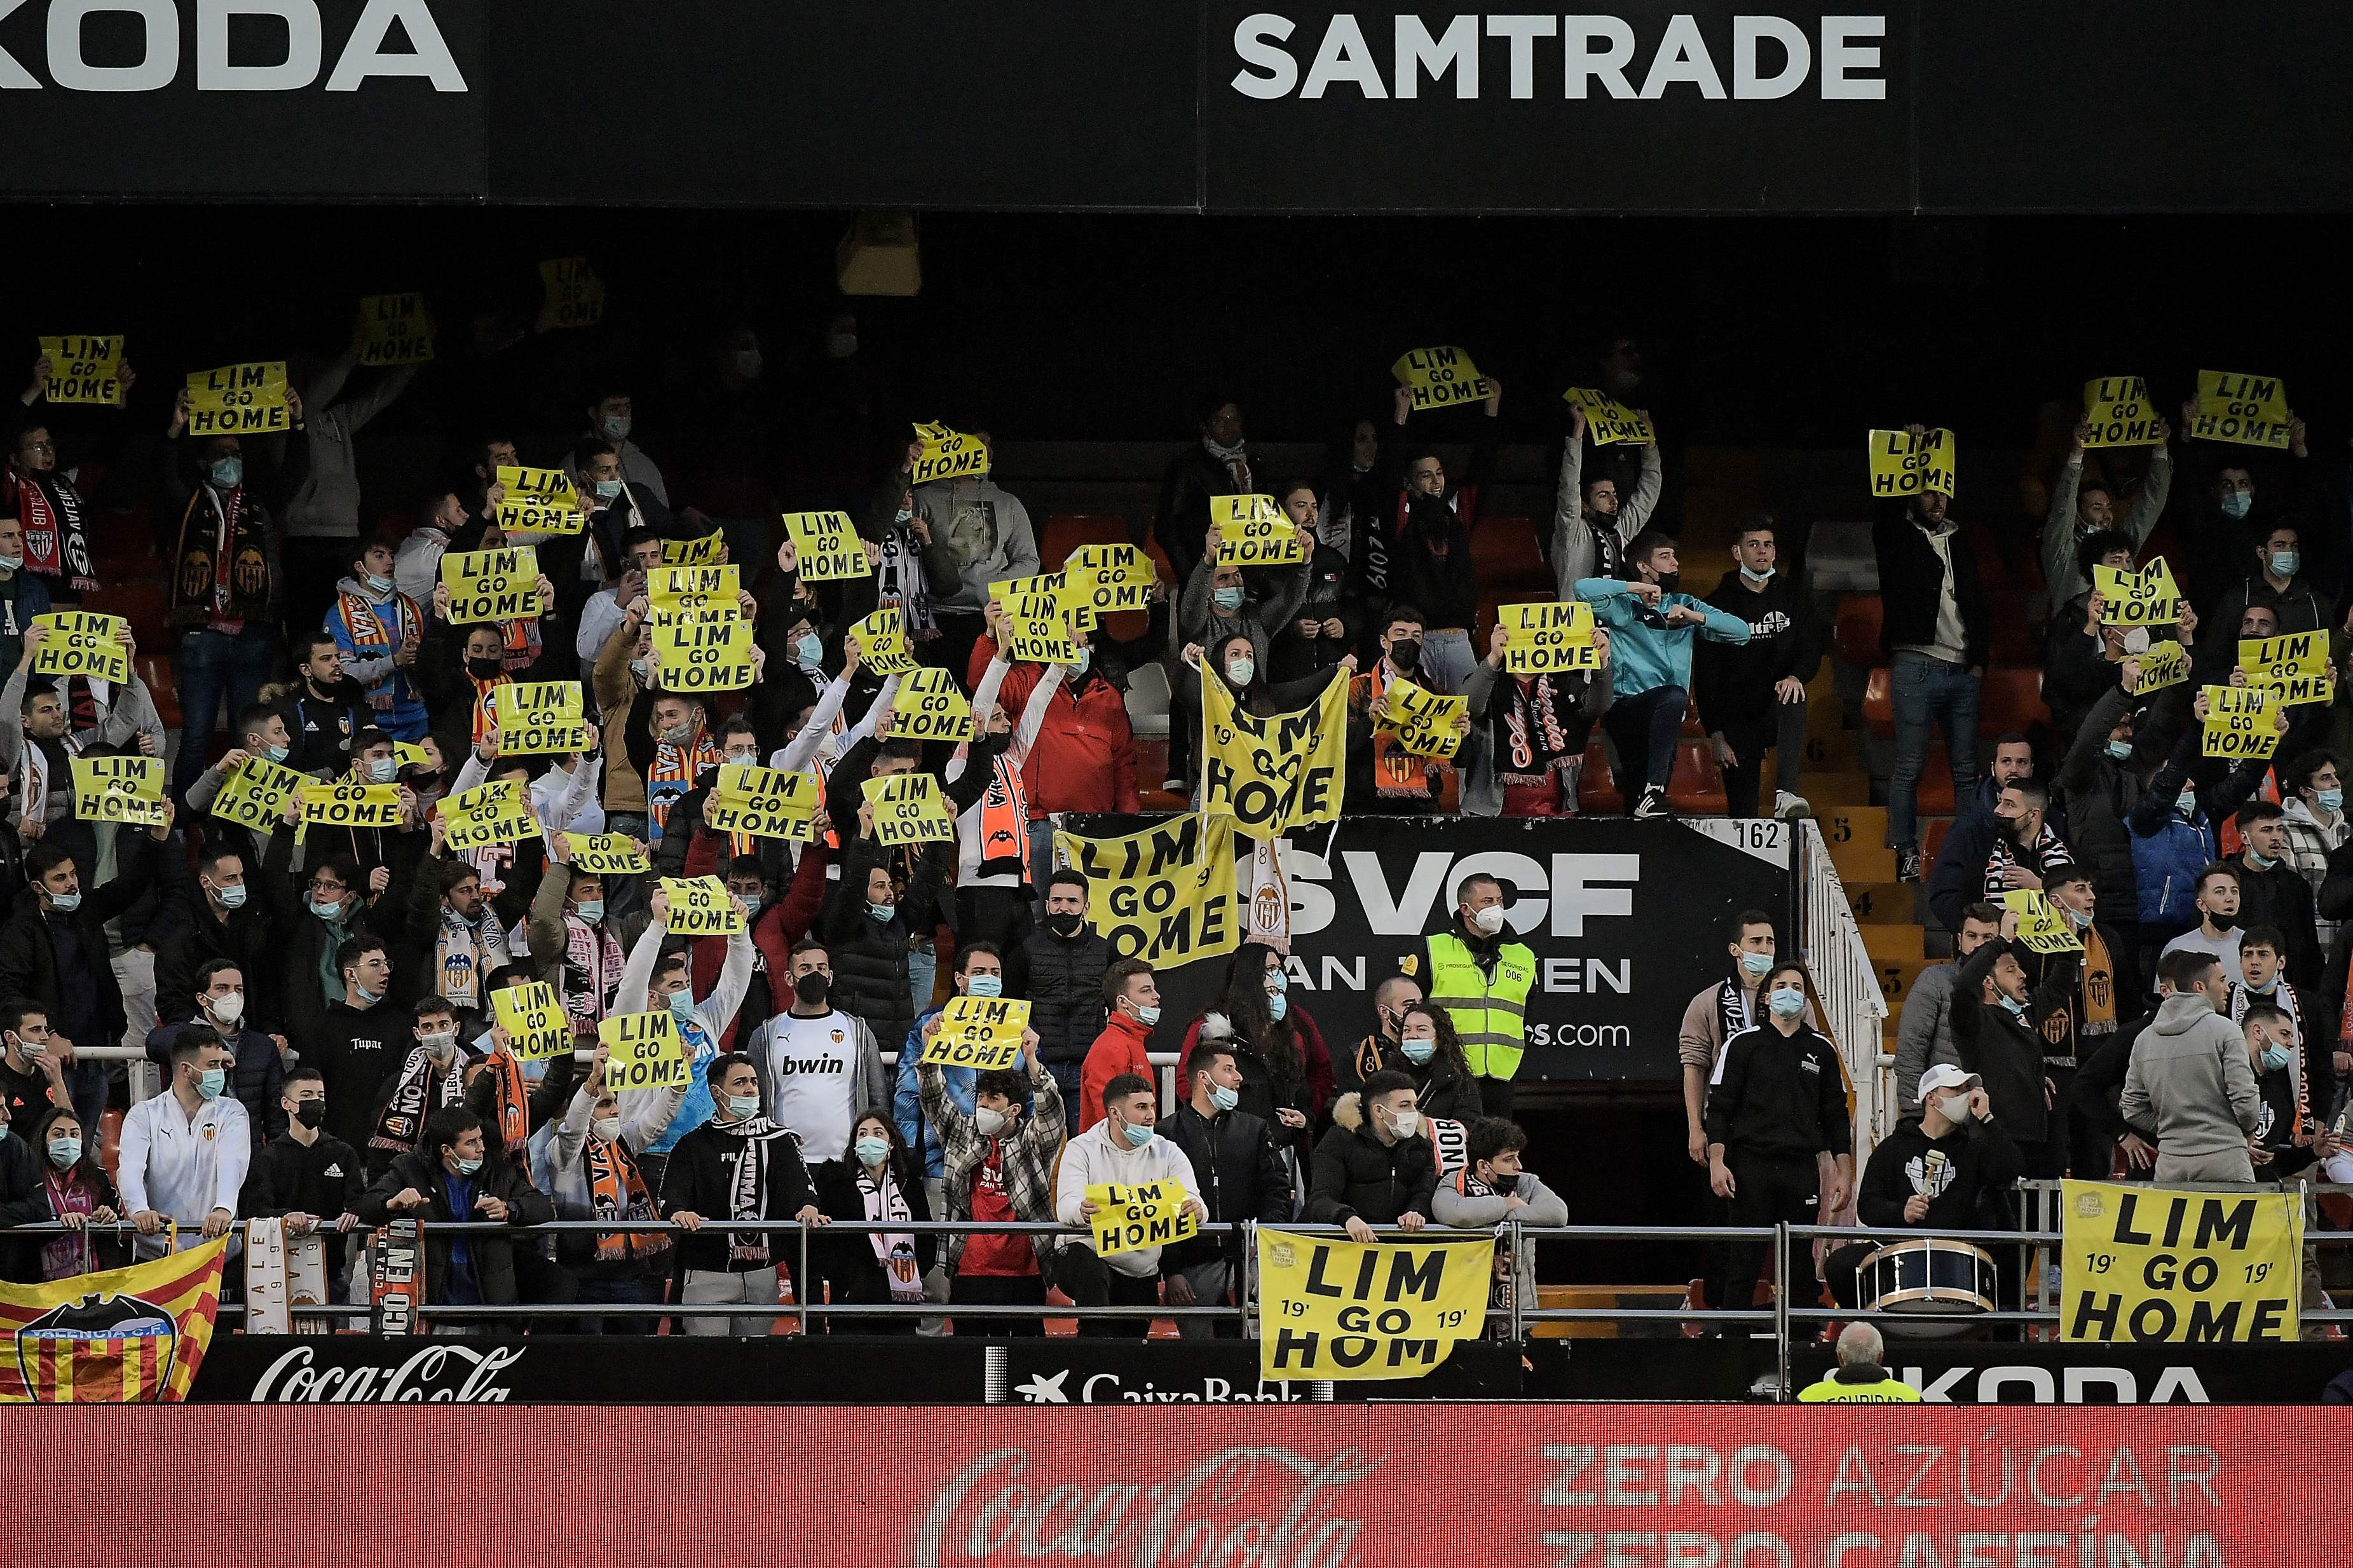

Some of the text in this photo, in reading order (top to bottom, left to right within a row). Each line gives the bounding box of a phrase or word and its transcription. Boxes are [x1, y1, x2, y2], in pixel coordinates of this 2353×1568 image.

[1231, 13, 1886, 100] SAMTRADE
[62, 339, 110, 360] LIM
[1408, 346, 1457, 369] LIM
[71, 362, 96, 376] GO
[208, 366, 264, 390] LIM
[1429, 369, 1454, 383] GO
[48, 378, 116, 399] HOME
[222, 391, 253, 406] GO
[1412, 379, 1489, 406] HOME
[2099, 379, 2146, 402] LIM
[2216, 376, 2276, 402] LIM
[194, 407, 283, 432] HOME
[2111, 404, 2139, 418] GO
[2228, 402, 2260, 418] GO
[1595, 420, 1647, 441] HOME
[2086, 421, 2159, 444] HOME
[2197, 414, 2291, 444] HOME
[940, 437, 963, 454] GO
[1887, 430, 1942, 455] LIM
[918, 449, 984, 479] HOME
[1902, 453, 1932, 470] GO
[516, 470, 568, 494] LIM
[1876, 468, 1954, 494] HOME
[525, 494, 554, 506] GO
[500, 509, 583, 530] HOME
[801, 515, 843, 536] LIM
[1244, 522, 1272, 537] GO
[661, 538, 711, 564] LIM
[817, 536, 839, 550] GO
[1218, 538, 1299, 562] HOME
[462, 552, 517, 578] LIM
[801, 553, 864, 576] HOME
[1082, 547, 1135, 568] LIM
[1367, 535, 1389, 590] 2019
[476, 577, 507, 594] GO
[669, 569, 721, 593] LIM
[1009, 573, 1065, 593] LIM
[1097, 569, 1127, 584] GO
[2115, 559, 2162, 589] LIM
[679, 594, 707, 607] GO
[2129, 583, 2156, 599] GO
[450, 591, 536, 619] HOME
[1020, 595, 1056, 620] LIM
[2103, 599, 2183, 620] HOME
[54, 615, 109, 636] LIM
[657, 608, 739, 627] HOME
[865, 611, 900, 636] LIM
[1520, 605, 1573, 629] LIM
[674, 624, 730, 647] LIM
[1028, 622, 1049, 636] GO
[1534, 631, 1563, 646] GO
[68, 634, 97, 649] GO
[873, 637, 892, 652] GO
[1014, 638, 1074, 658] HOME
[2259, 636, 2311, 664] LIM
[39, 650, 124, 678] HOME
[688, 648, 720, 664] GO
[862, 650, 911, 674] HOME
[1510, 646, 1593, 669] HOME
[662, 665, 751, 687] HOME
[2136, 657, 2182, 690] HOME
[2270, 662, 2299, 678] GO
[910, 669, 958, 695] LIM
[515, 685, 566, 710] LIM
[920, 697, 949, 712] GO
[1402, 689, 1455, 718] LIM
[2219, 690, 2264, 714] LIM
[528, 711, 556, 726] GO
[893, 711, 972, 738] HOME
[1410, 715, 1433, 730] GO
[2230, 716, 2253, 730] GO
[503, 727, 583, 751] HOME
[1377, 717, 1456, 754] HOME
[2206, 732, 2276, 755] HOME
[1806, 739, 1824, 762] 6
[92, 760, 147, 779] LIM
[242, 759, 299, 795] LIM
[1252, 749, 1302, 782] GO
[108, 779, 137, 794] GO
[334, 786, 366, 800] GO
[737, 768, 799, 798] LIM
[883, 777, 928, 802] LIM
[1206, 756, 1335, 830] HOME
[81, 794, 164, 817] HOME
[249, 786, 279, 806] GO
[459, 784, 508, 812] LIM
[748, 796, 782, 812] GO
[306, 803, 397, 823] HOME
[470, 803, 499, 822] GO
[896, 803, 920, 818] GO
[449, 815, 535, 847] HOME
[717, 808, 811, 838] HOME
[882, 818, 951, 841] HOME
[1834, 818, 1851, 842] 5
[589, 836, 611, 851] GO
[1739, 823, 1778, 849] 162
[1081, 817, 1199, 880] LIM
[1258, 846, 1268, 865] 8
[574, 853, 650, 871] HOME
[688, 892, 710, 907] GO
[1109, 880, 1176, 918] GO
[1853, 893, 1872, 916] 4
[671, 910, 737, 931] HOME
[2026, 932, 2080, 950] HOME
[1285, 955, 1366, 991] AN
[1505, 969, 1522, 983] 006
[1883, 969, 1902, 993] 3
[513, 985, 550, 1013] LIM
[527, 1014, 547, 1029] GO
[954, 1000, 1009, 1025] LIM
[620, 1014, 668, 1041] LIM
[964, 1026, 993, 1042] GO
[1527, 1023, 1630, 1047] s.com
[509, 1031, 570, 1058] HOME
[634, 1041, 660, 1059] GO
[929, 1040, 1017, 1065] HOME
[610, 1059, 687, 1088] HOME
[782, 1053, 843, 1075] bwin
[1365, 1058, 1374, 1072] 8
[324, 1169, 344, 1178] adidas
[1109, 1184, 1163, 1207] LIM
[1126, 1204, 1157, 1220] GO
[2113, 1194, 2257, 1250] LIM
[1101, 1211, 1190, 1253] HOME
[375, 1224, 388, 1289] COPA DEL
[386, 1248, 415, 1284] EN
[1305, 1246, 1447, 1302] LIM
[2087, 1253, 2273, 1292] 19' GO 19'
[1281, 1299, 1468, 1334] 19' GO 19'
[2071, 1290, 2288, 1342] HOME
[33, 1328, 126, 1340] VALENCIA
[1541, 1428, 2223, 1508] ZERO AZÚCAR
[1541, 1514, 2234, 1568] ZERO CAFEÍNA
